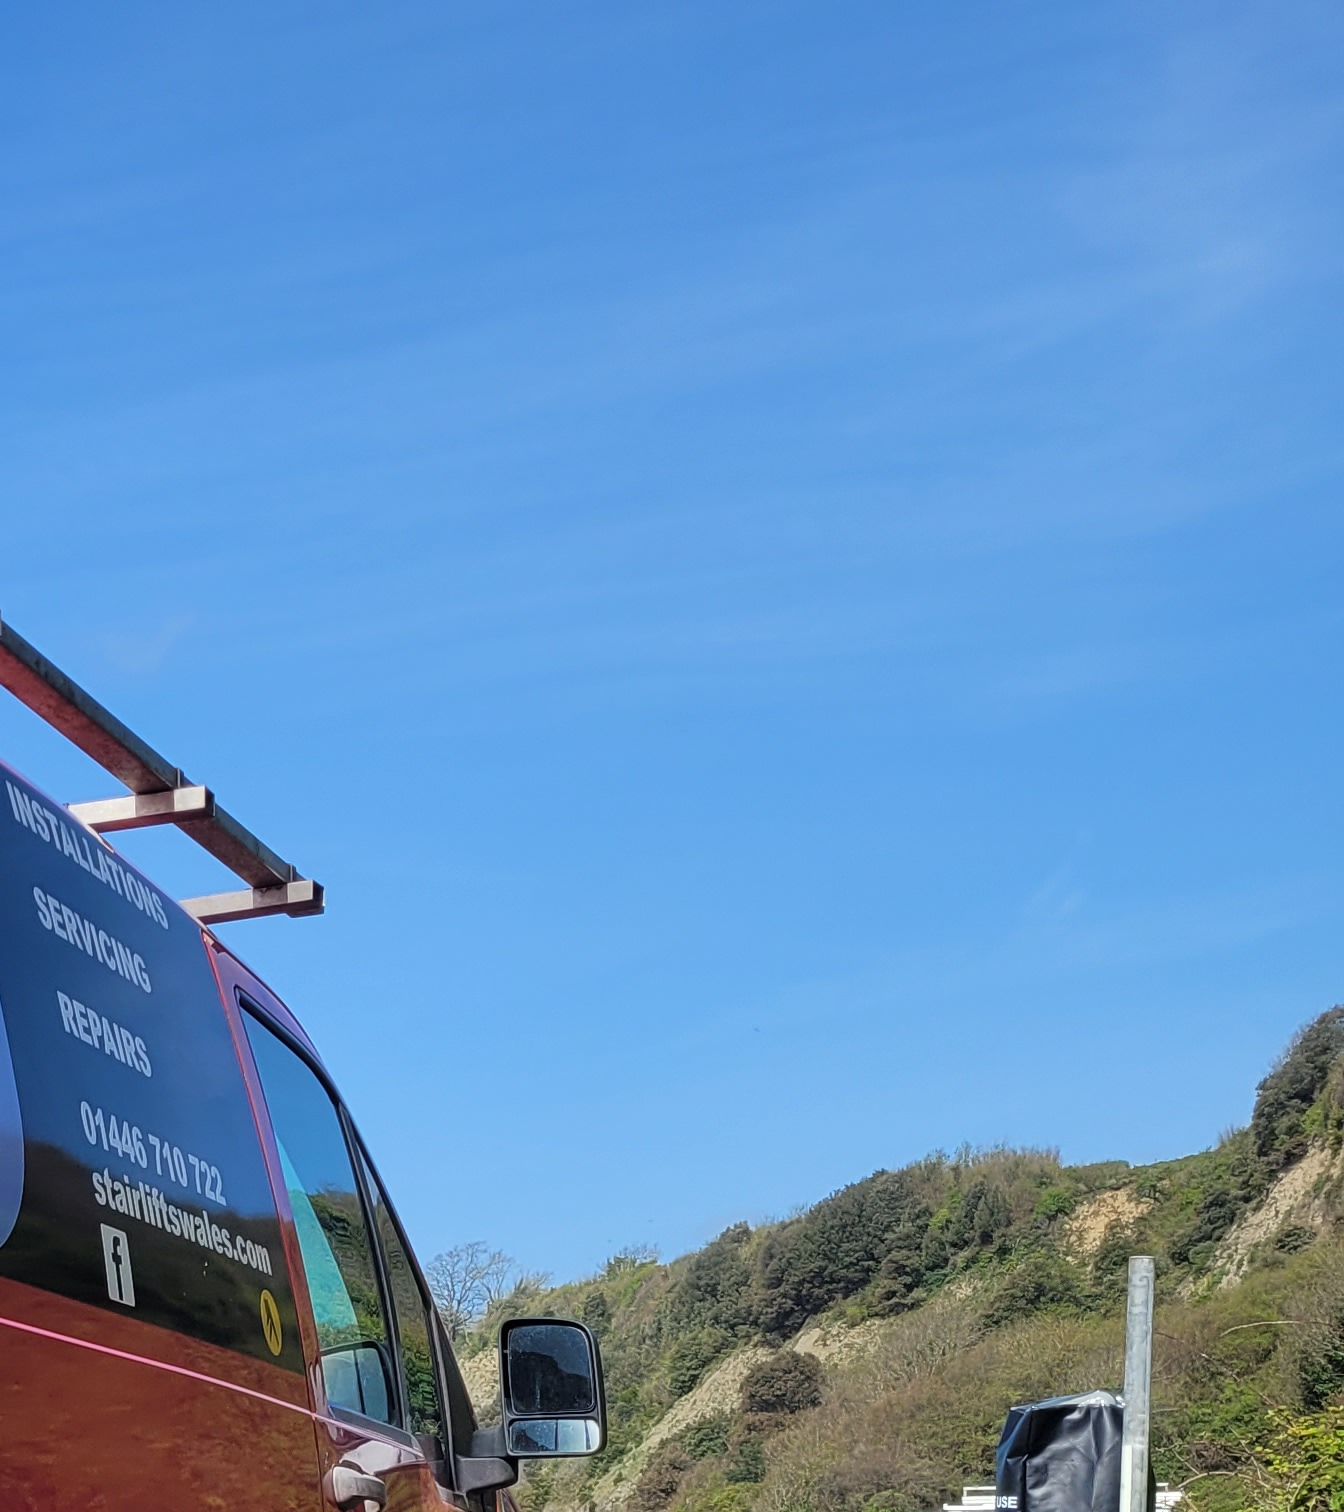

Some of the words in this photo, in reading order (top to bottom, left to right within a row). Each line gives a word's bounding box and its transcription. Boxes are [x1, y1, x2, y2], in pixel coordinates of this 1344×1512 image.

[5, 780, 169, 930] INSTALLATIONS
[33, 886, 152, 994] SERVICING
[56, 990, 152, 1078] REPAIRS
[80, 1100, 148, 1169] 01446
[147, 1133, 188, 1188] 710
[188, 1153, 227, 1206] 722
[92, 1167, 273, 1276] stairliftswales.com
[996, 1495, 1018, 1509] USE
